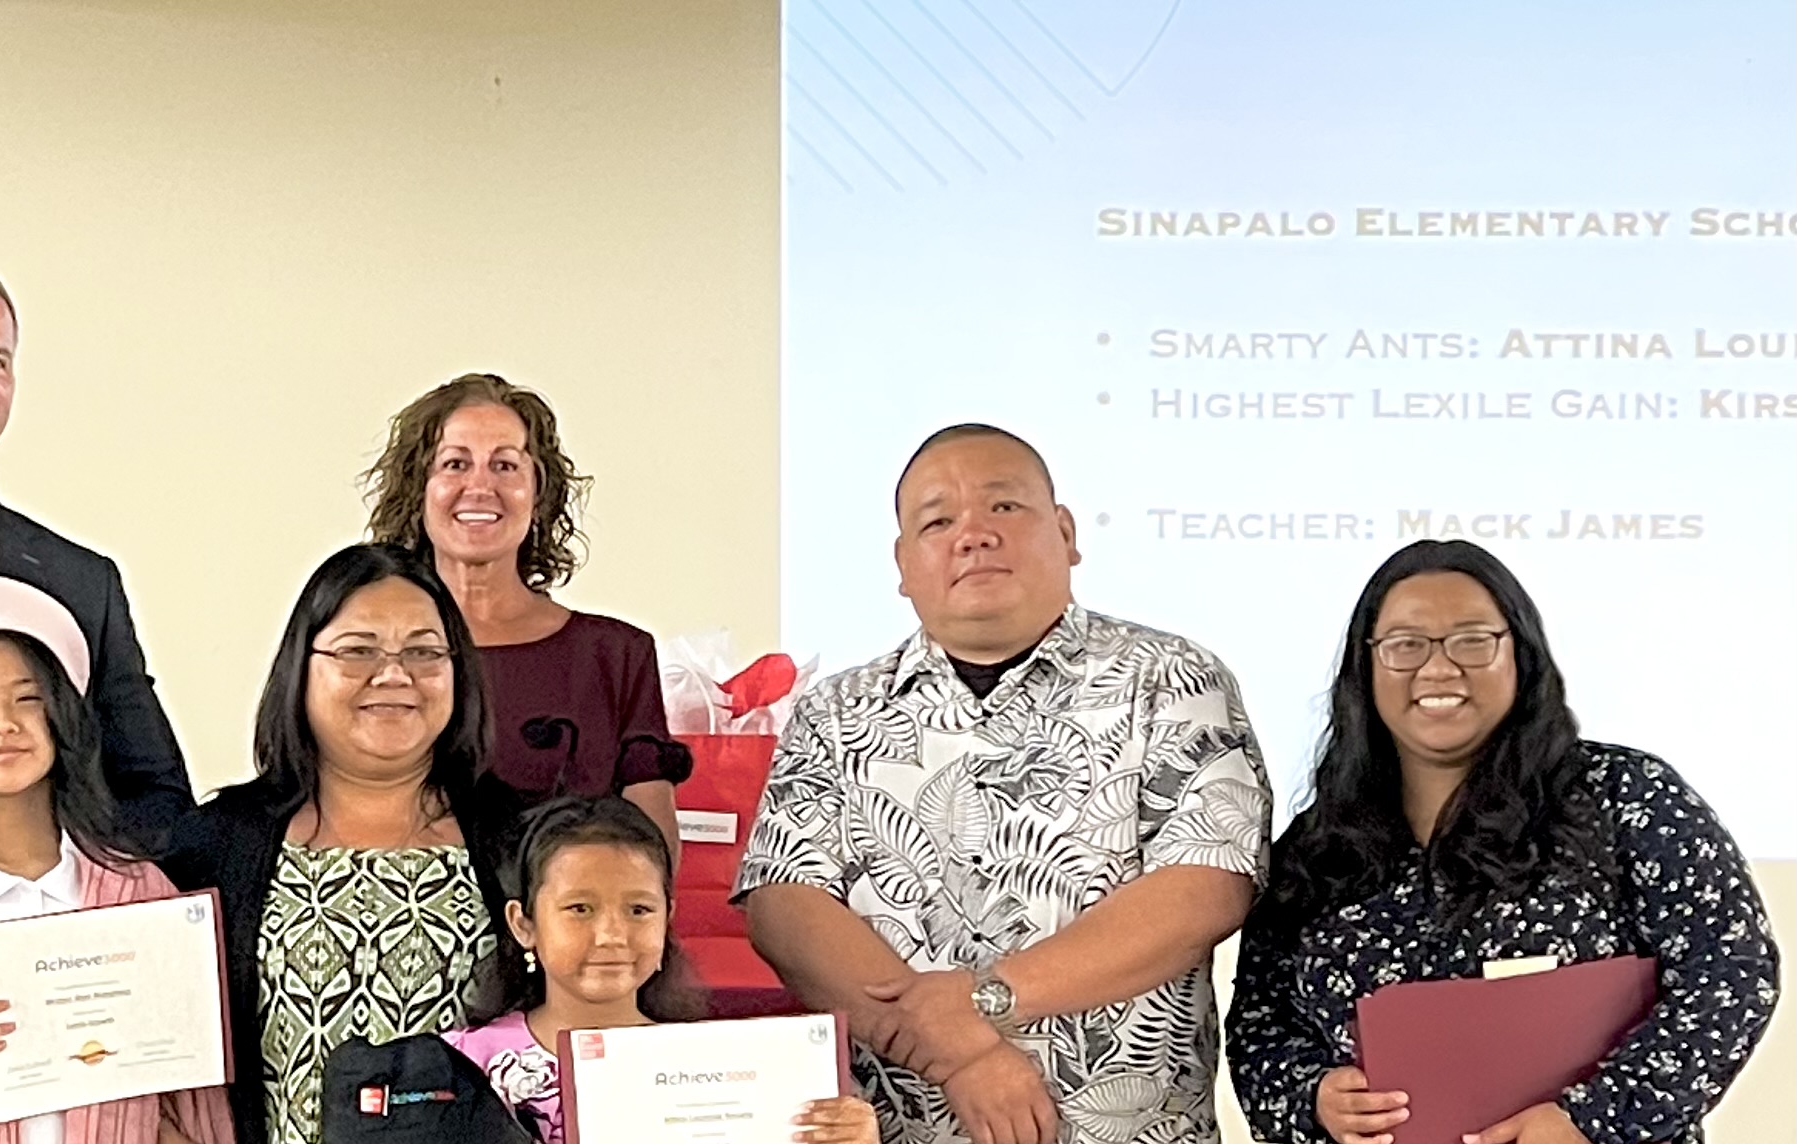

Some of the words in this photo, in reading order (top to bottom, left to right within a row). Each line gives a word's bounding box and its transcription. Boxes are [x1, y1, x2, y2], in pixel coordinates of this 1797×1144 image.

[1097, 207, 1337, 237] SINAPALO
[1354, 207, 1671, 238] ELEMENTARY
[1689, 206, 1797, 238] SCH
[1149, 328, 1328, 360] SMARTY
[1345, 328, 1480, 360] ANTS:
[1497, 328, 1673, 360] ATTINA
[1694, 327, 1797, 359] LOU
[1150, 388, 1355, 420] HIGHEST
[1371, 388, 1533, 420] LEXILE
[1550, 388, 1678, 420] GAIN:
[1146, 508, 1374, 541] TEACHER:
[1397, 509, 1532, 541] MACK
[1546, 508, 1704, 541] JAMES
